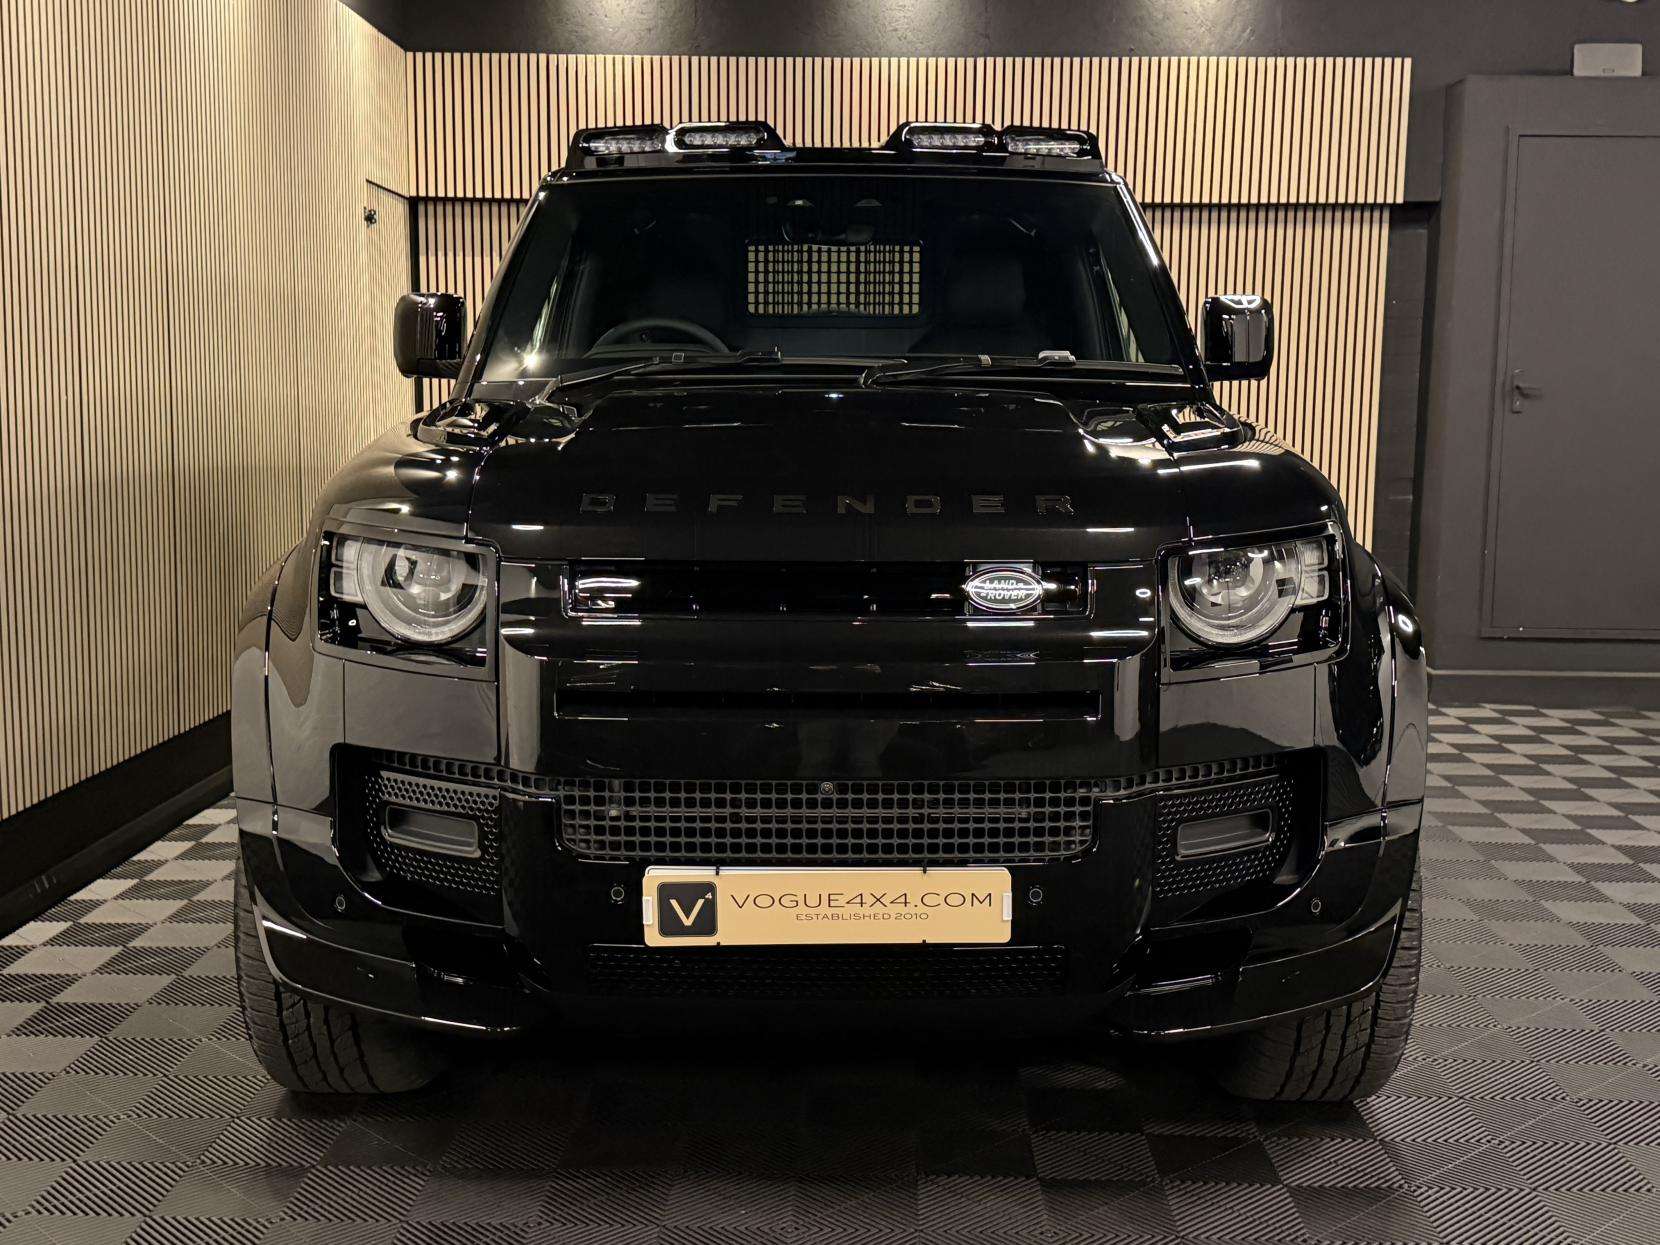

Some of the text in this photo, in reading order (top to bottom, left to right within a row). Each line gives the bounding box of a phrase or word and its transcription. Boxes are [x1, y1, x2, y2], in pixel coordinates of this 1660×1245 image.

[580, 493, 1075, 514] DEFENDER
[985, 579, 1016, 590] LAND
[987, 589, 1026, 600] ROVER
[730, 892, 992, 909] VOGUE4X4.COM
[795, 912, 929, 921] ESTABLISHED 2010
